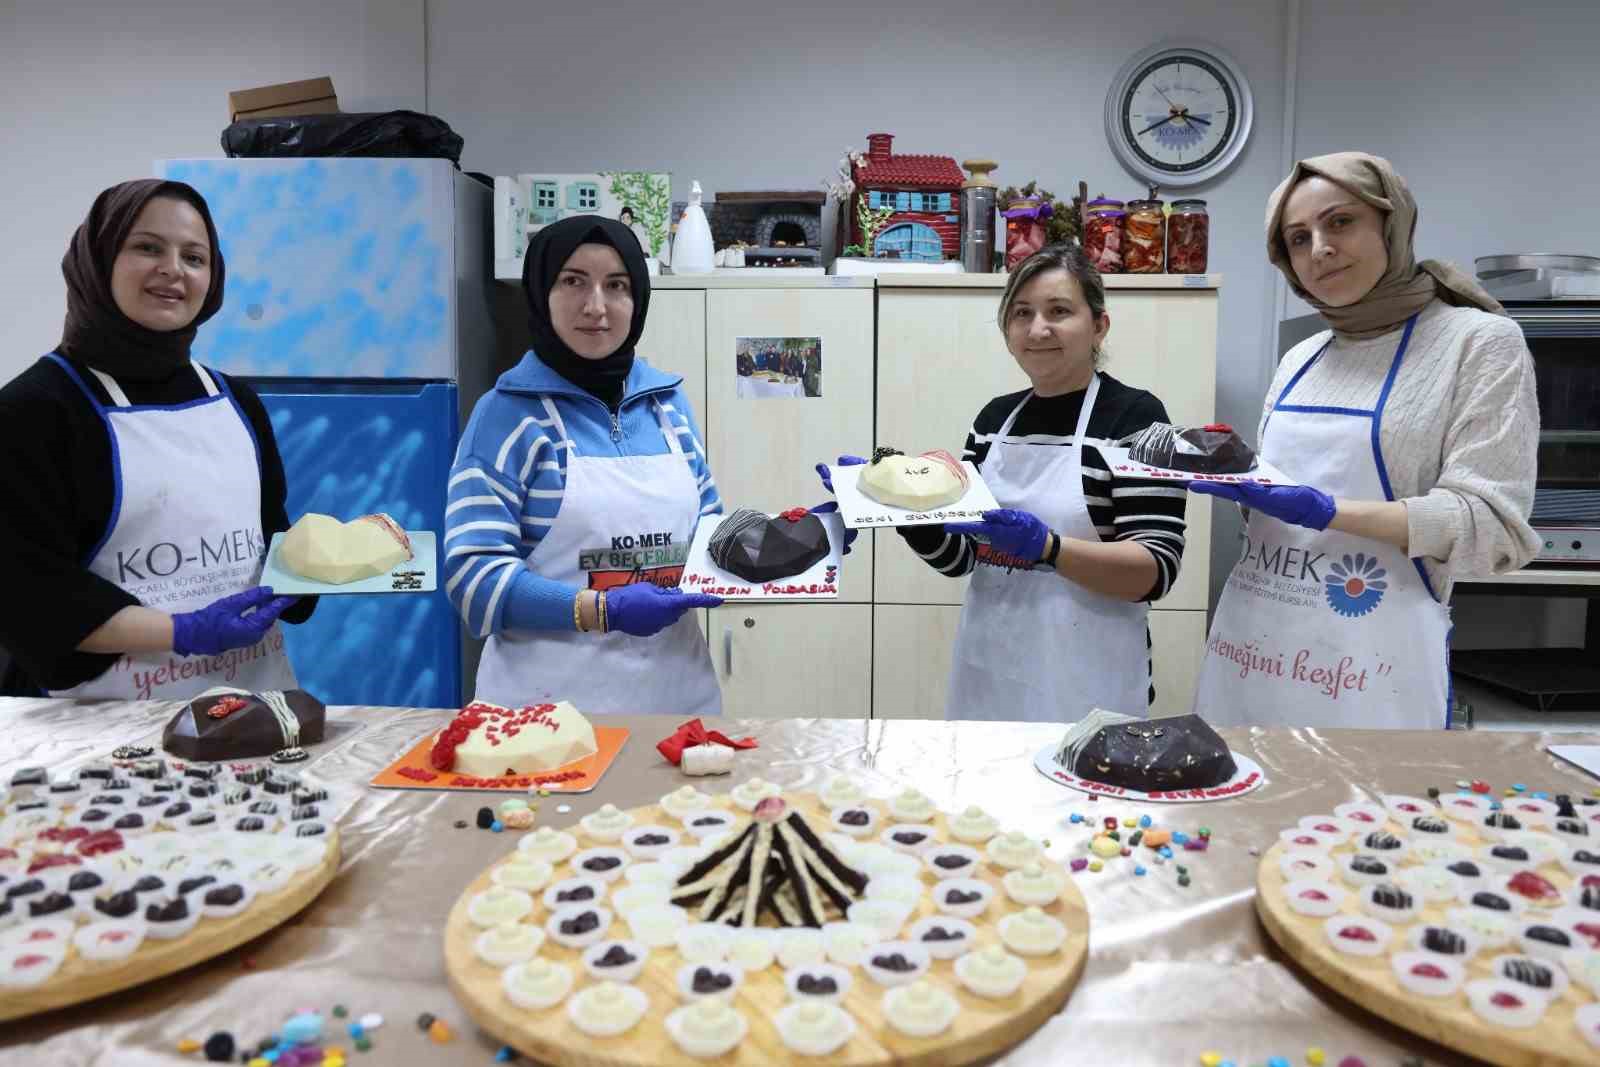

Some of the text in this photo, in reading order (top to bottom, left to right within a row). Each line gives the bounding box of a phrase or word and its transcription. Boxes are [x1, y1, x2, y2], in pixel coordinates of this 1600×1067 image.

[117, 527, 258, 583] KO-MEK
[579, 553, 603, 571] EV
[1292, 649, 1368, 699] keşfet
